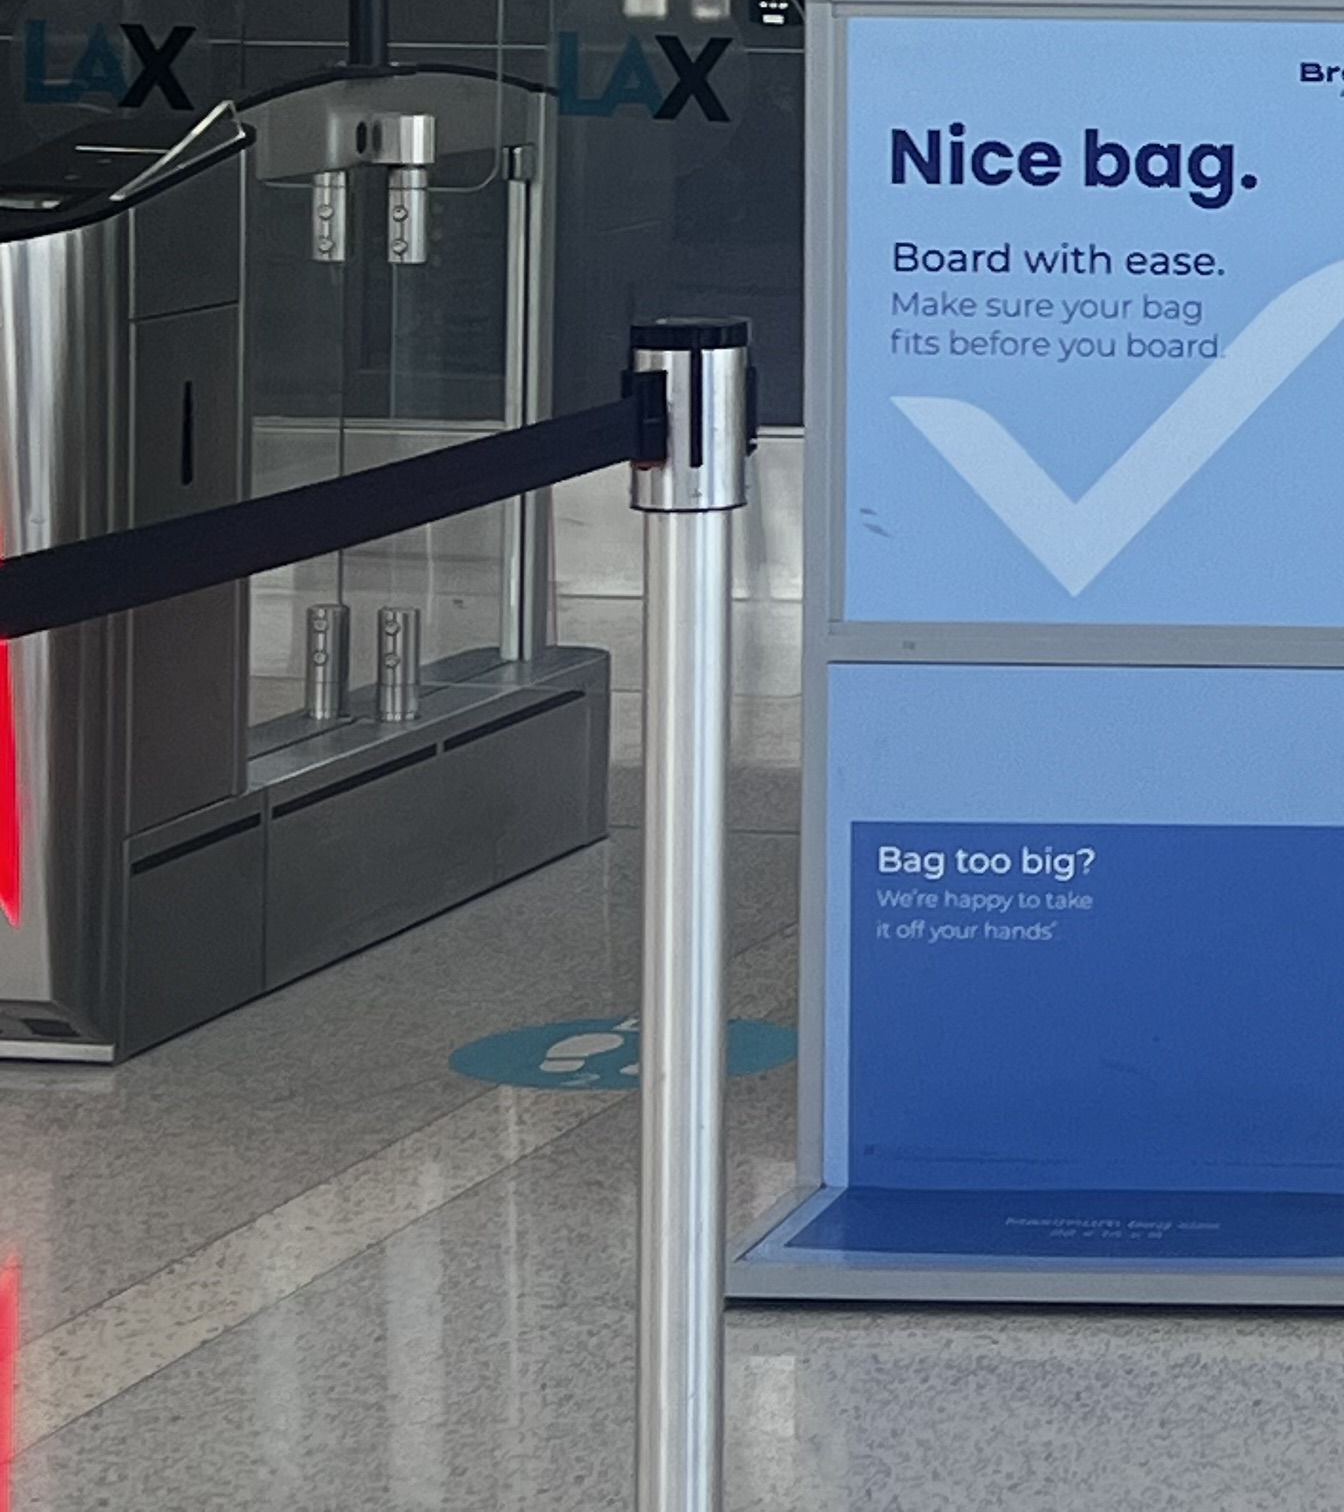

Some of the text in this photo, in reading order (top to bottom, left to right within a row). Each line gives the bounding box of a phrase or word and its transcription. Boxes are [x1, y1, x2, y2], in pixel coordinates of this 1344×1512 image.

[24, 19, 197, 111] LAX
[557, 31, 733, 123] LAX
[890, 122, 1258, 209] Nice bag.
[893, 242, 1225, 276] Board with ease.
[891, 291, 1203, 326] Make sure your bag
[890, 328, 1226, 363] fits before you board.
[878, 845, 1096, 882] Bag too big?
[943, 889, 1013, 914] happy
[1018, 891, 1041, 909] to
[1046, 891, 1094, 911] take
[876, 920, 891, 939] it
[896, 920, 926, 939] off
[929, 922, 979, 945] your
